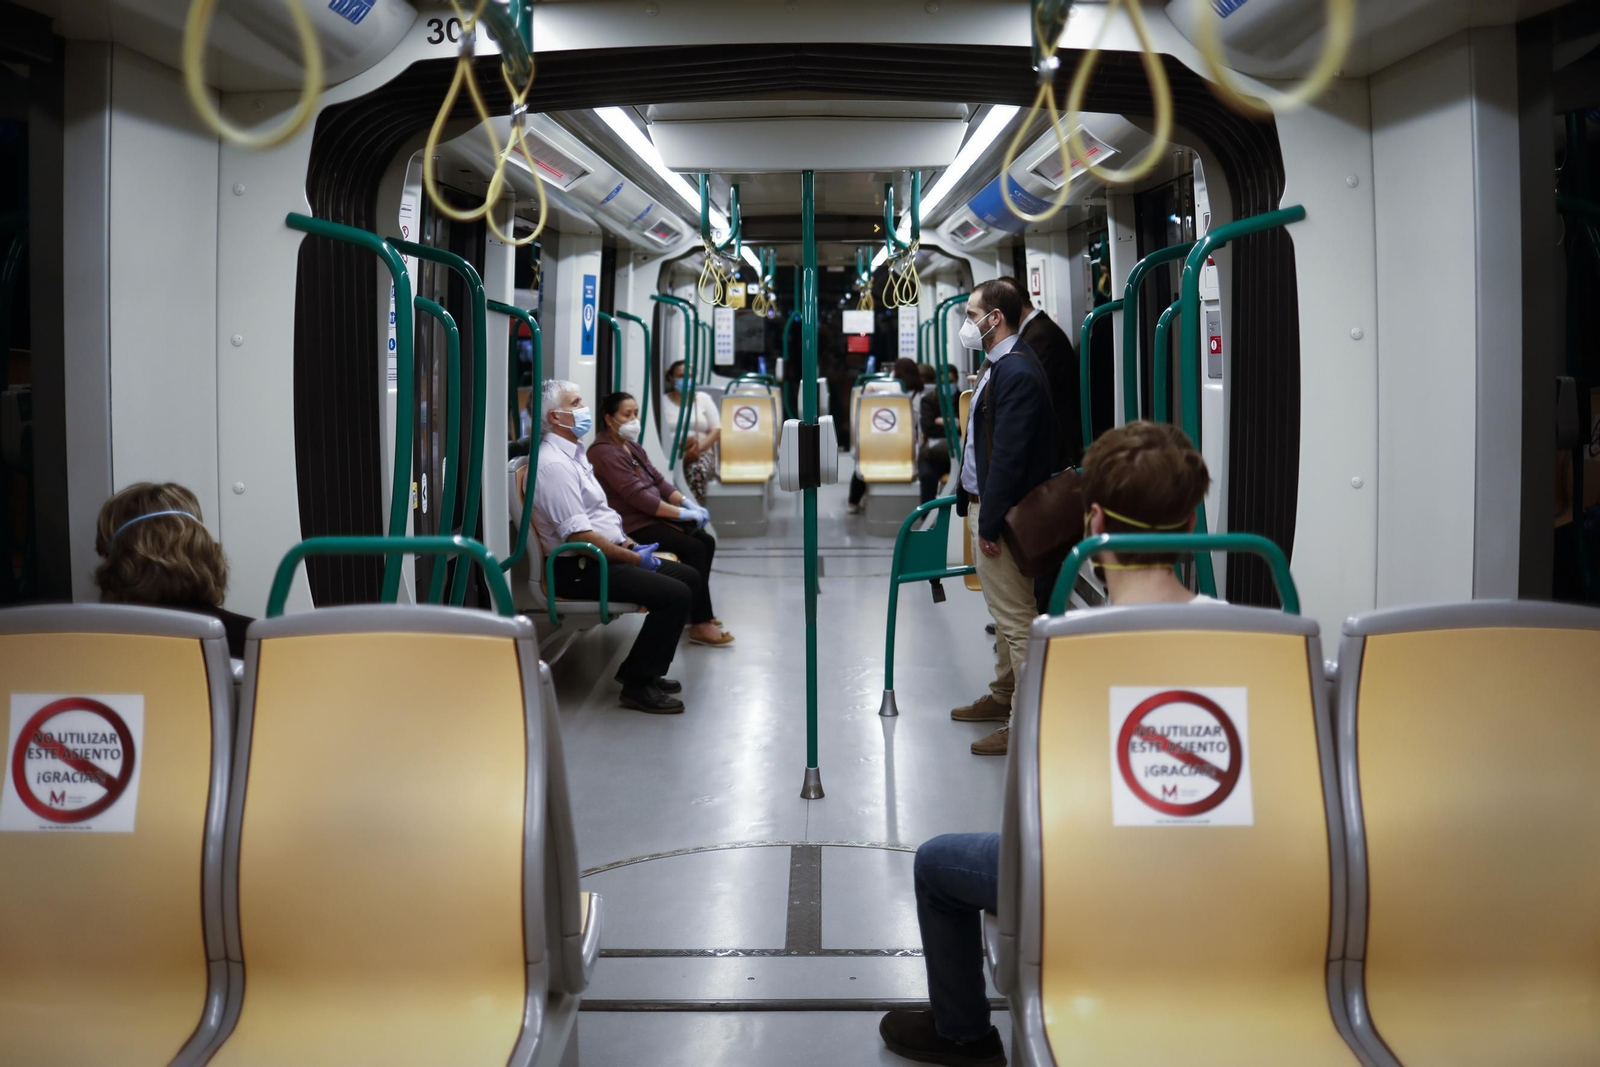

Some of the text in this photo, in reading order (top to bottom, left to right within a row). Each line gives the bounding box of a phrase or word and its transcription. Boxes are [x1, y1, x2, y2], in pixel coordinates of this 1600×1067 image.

[1135, 726, 1222, 737] NO UTILIZAR
[33, 732, 118, 745] NO UTILIZAR
[1130, 741, 1228, 753] ESTE ASIENTO
[27, 747, 121, 760] ESTE ASIENTO
